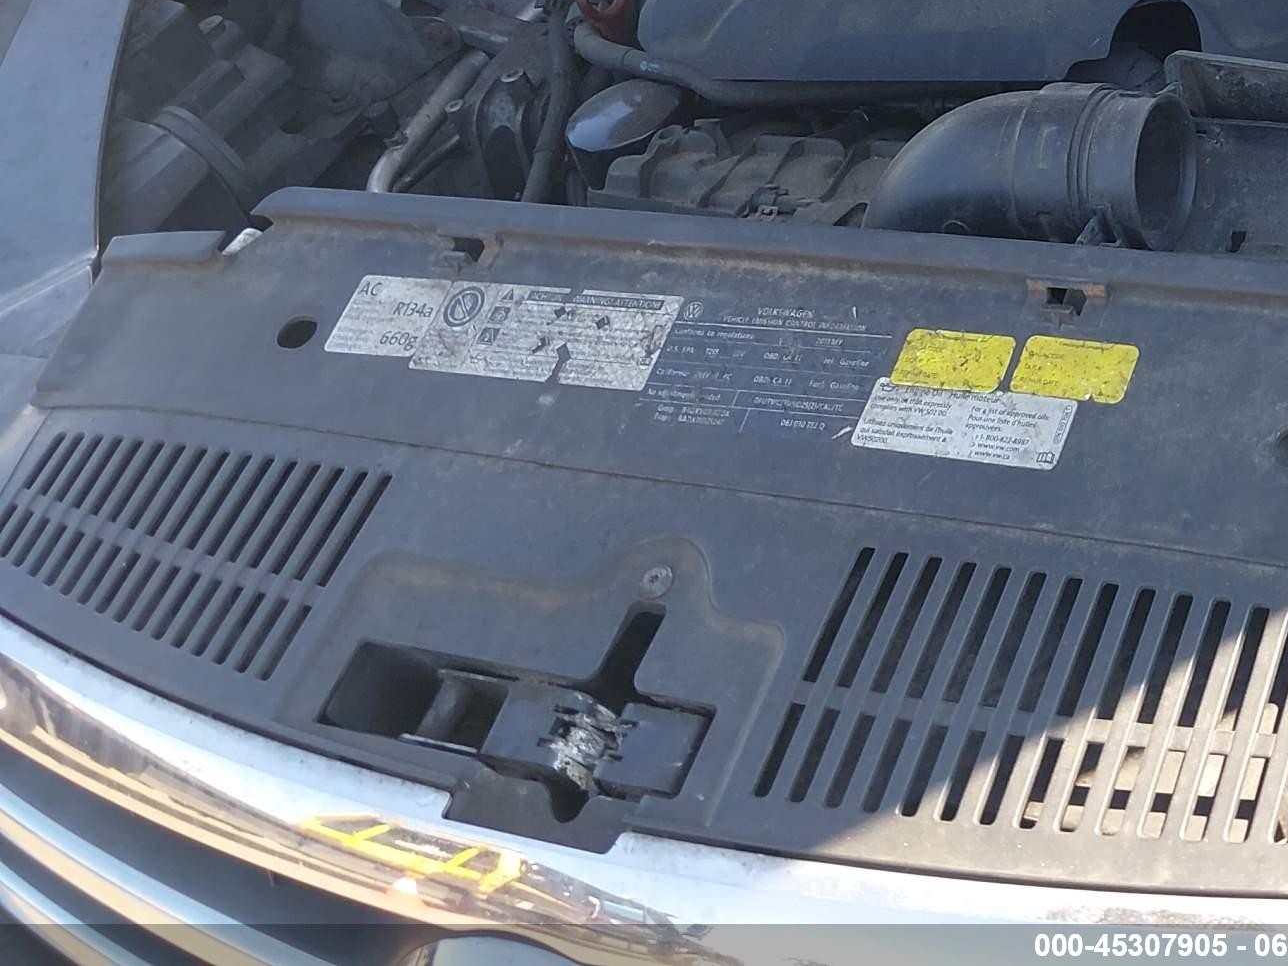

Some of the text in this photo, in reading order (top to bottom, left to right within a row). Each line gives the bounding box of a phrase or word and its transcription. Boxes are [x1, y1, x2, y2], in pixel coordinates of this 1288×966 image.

[359, 281, 383, 297] AC
[392, 300, 434, 318] R134a
[379, 330, 418, 352] 660g
[970, 394, 1000, 404] moteur
